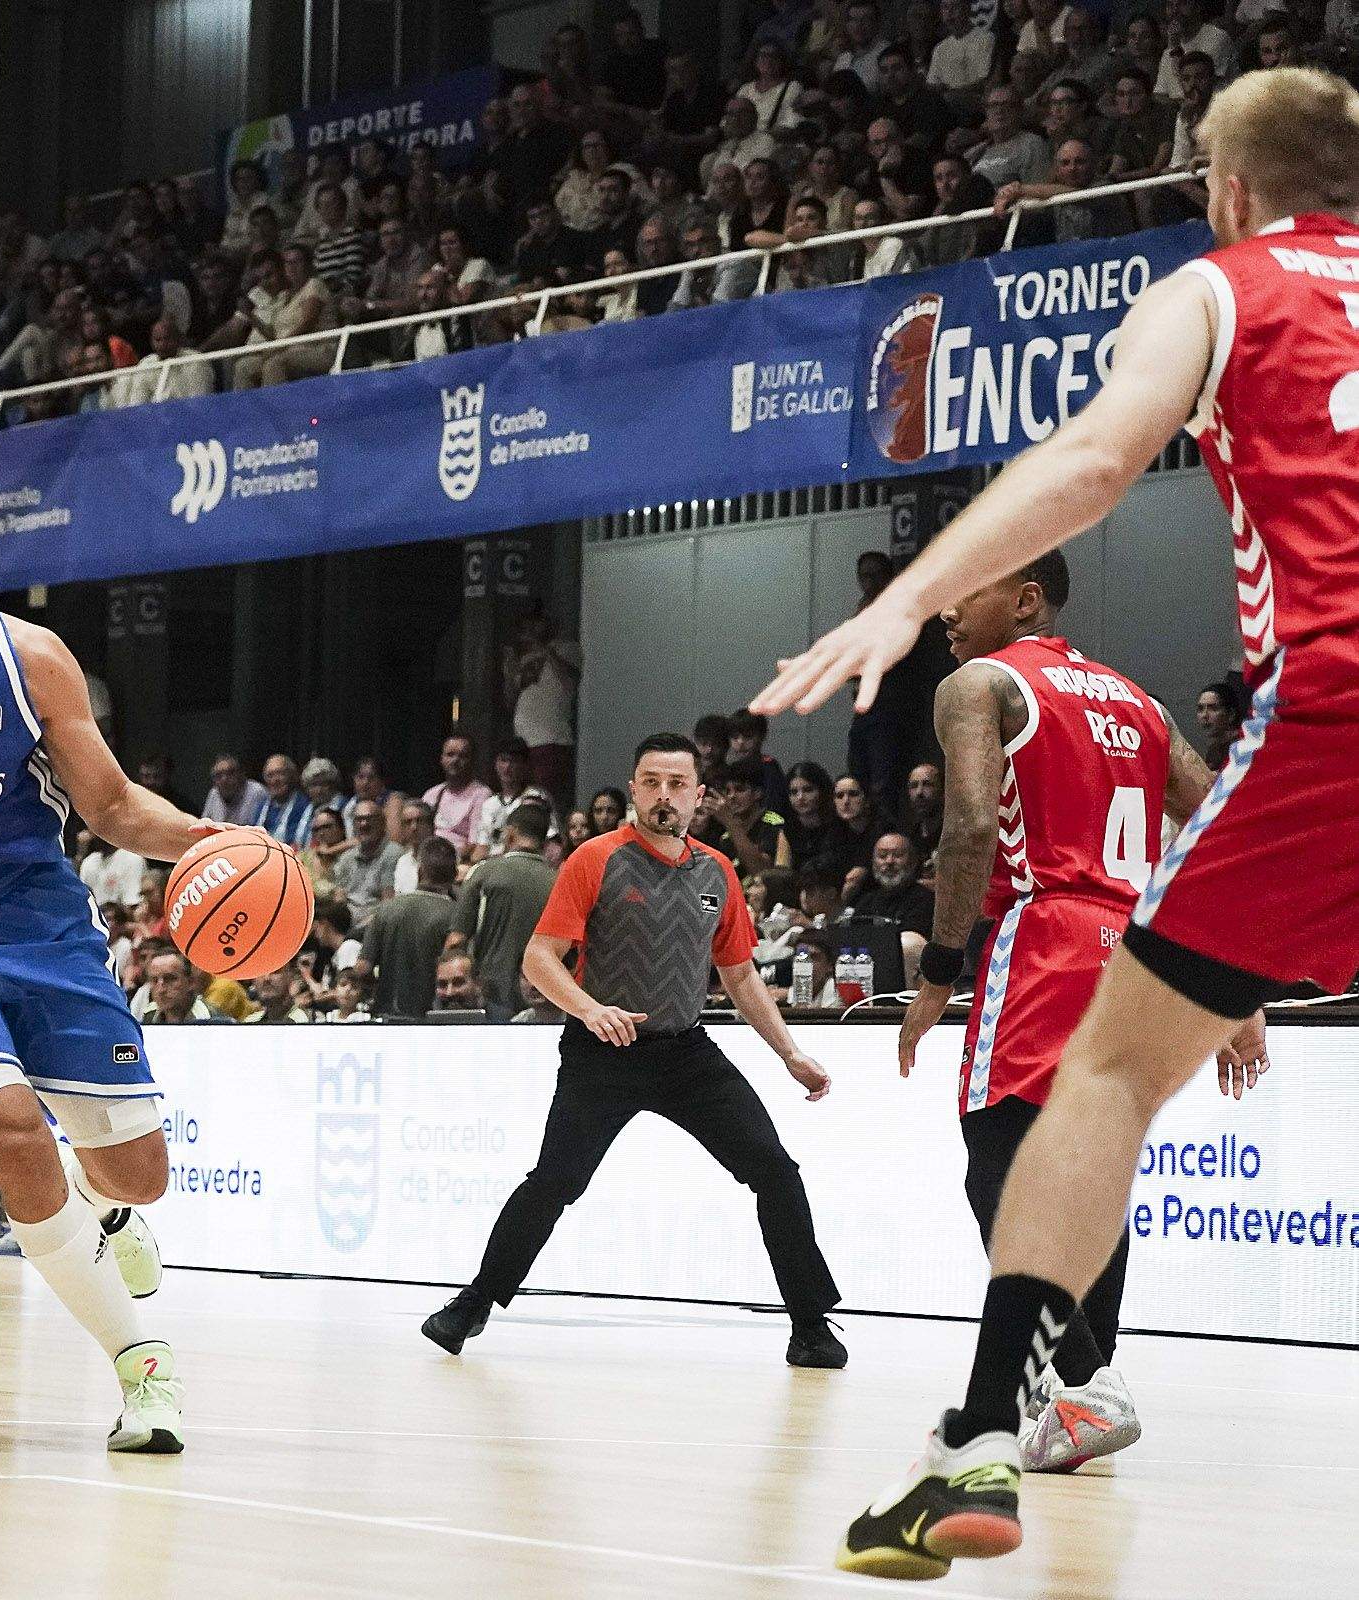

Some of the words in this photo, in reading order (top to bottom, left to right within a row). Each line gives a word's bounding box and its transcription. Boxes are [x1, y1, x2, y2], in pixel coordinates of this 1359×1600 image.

[308, 100, 424, 147] DEPORTE
[993, 255, 1150, 322] TORNEO
[759, 361, 824, 390] XUNTA
[490, 406, 548, 437] Concello
[756, 394, 780, 421] DE
[233, 434, 319, 472] Deputación
[490, 443, 509, 466] de
[509, 431, 591, 462] Pontevedra
[231, 468, 319, 499] Pontevedra
[1084, 709, 1141, 751] Río
[1102, 786, 1152, 895] 4
[169, 857, 238, 932] Wilson
[218, 911, 249, 945] acb
[116, 1050, 136, 1061] acb
[162, 1109, 199, 1145] ello
[400, 1115, 507, 1155] Concello
[1139, 1133, 1261, 1179] oncello
[1134, 1203, 1153, 1238] e
